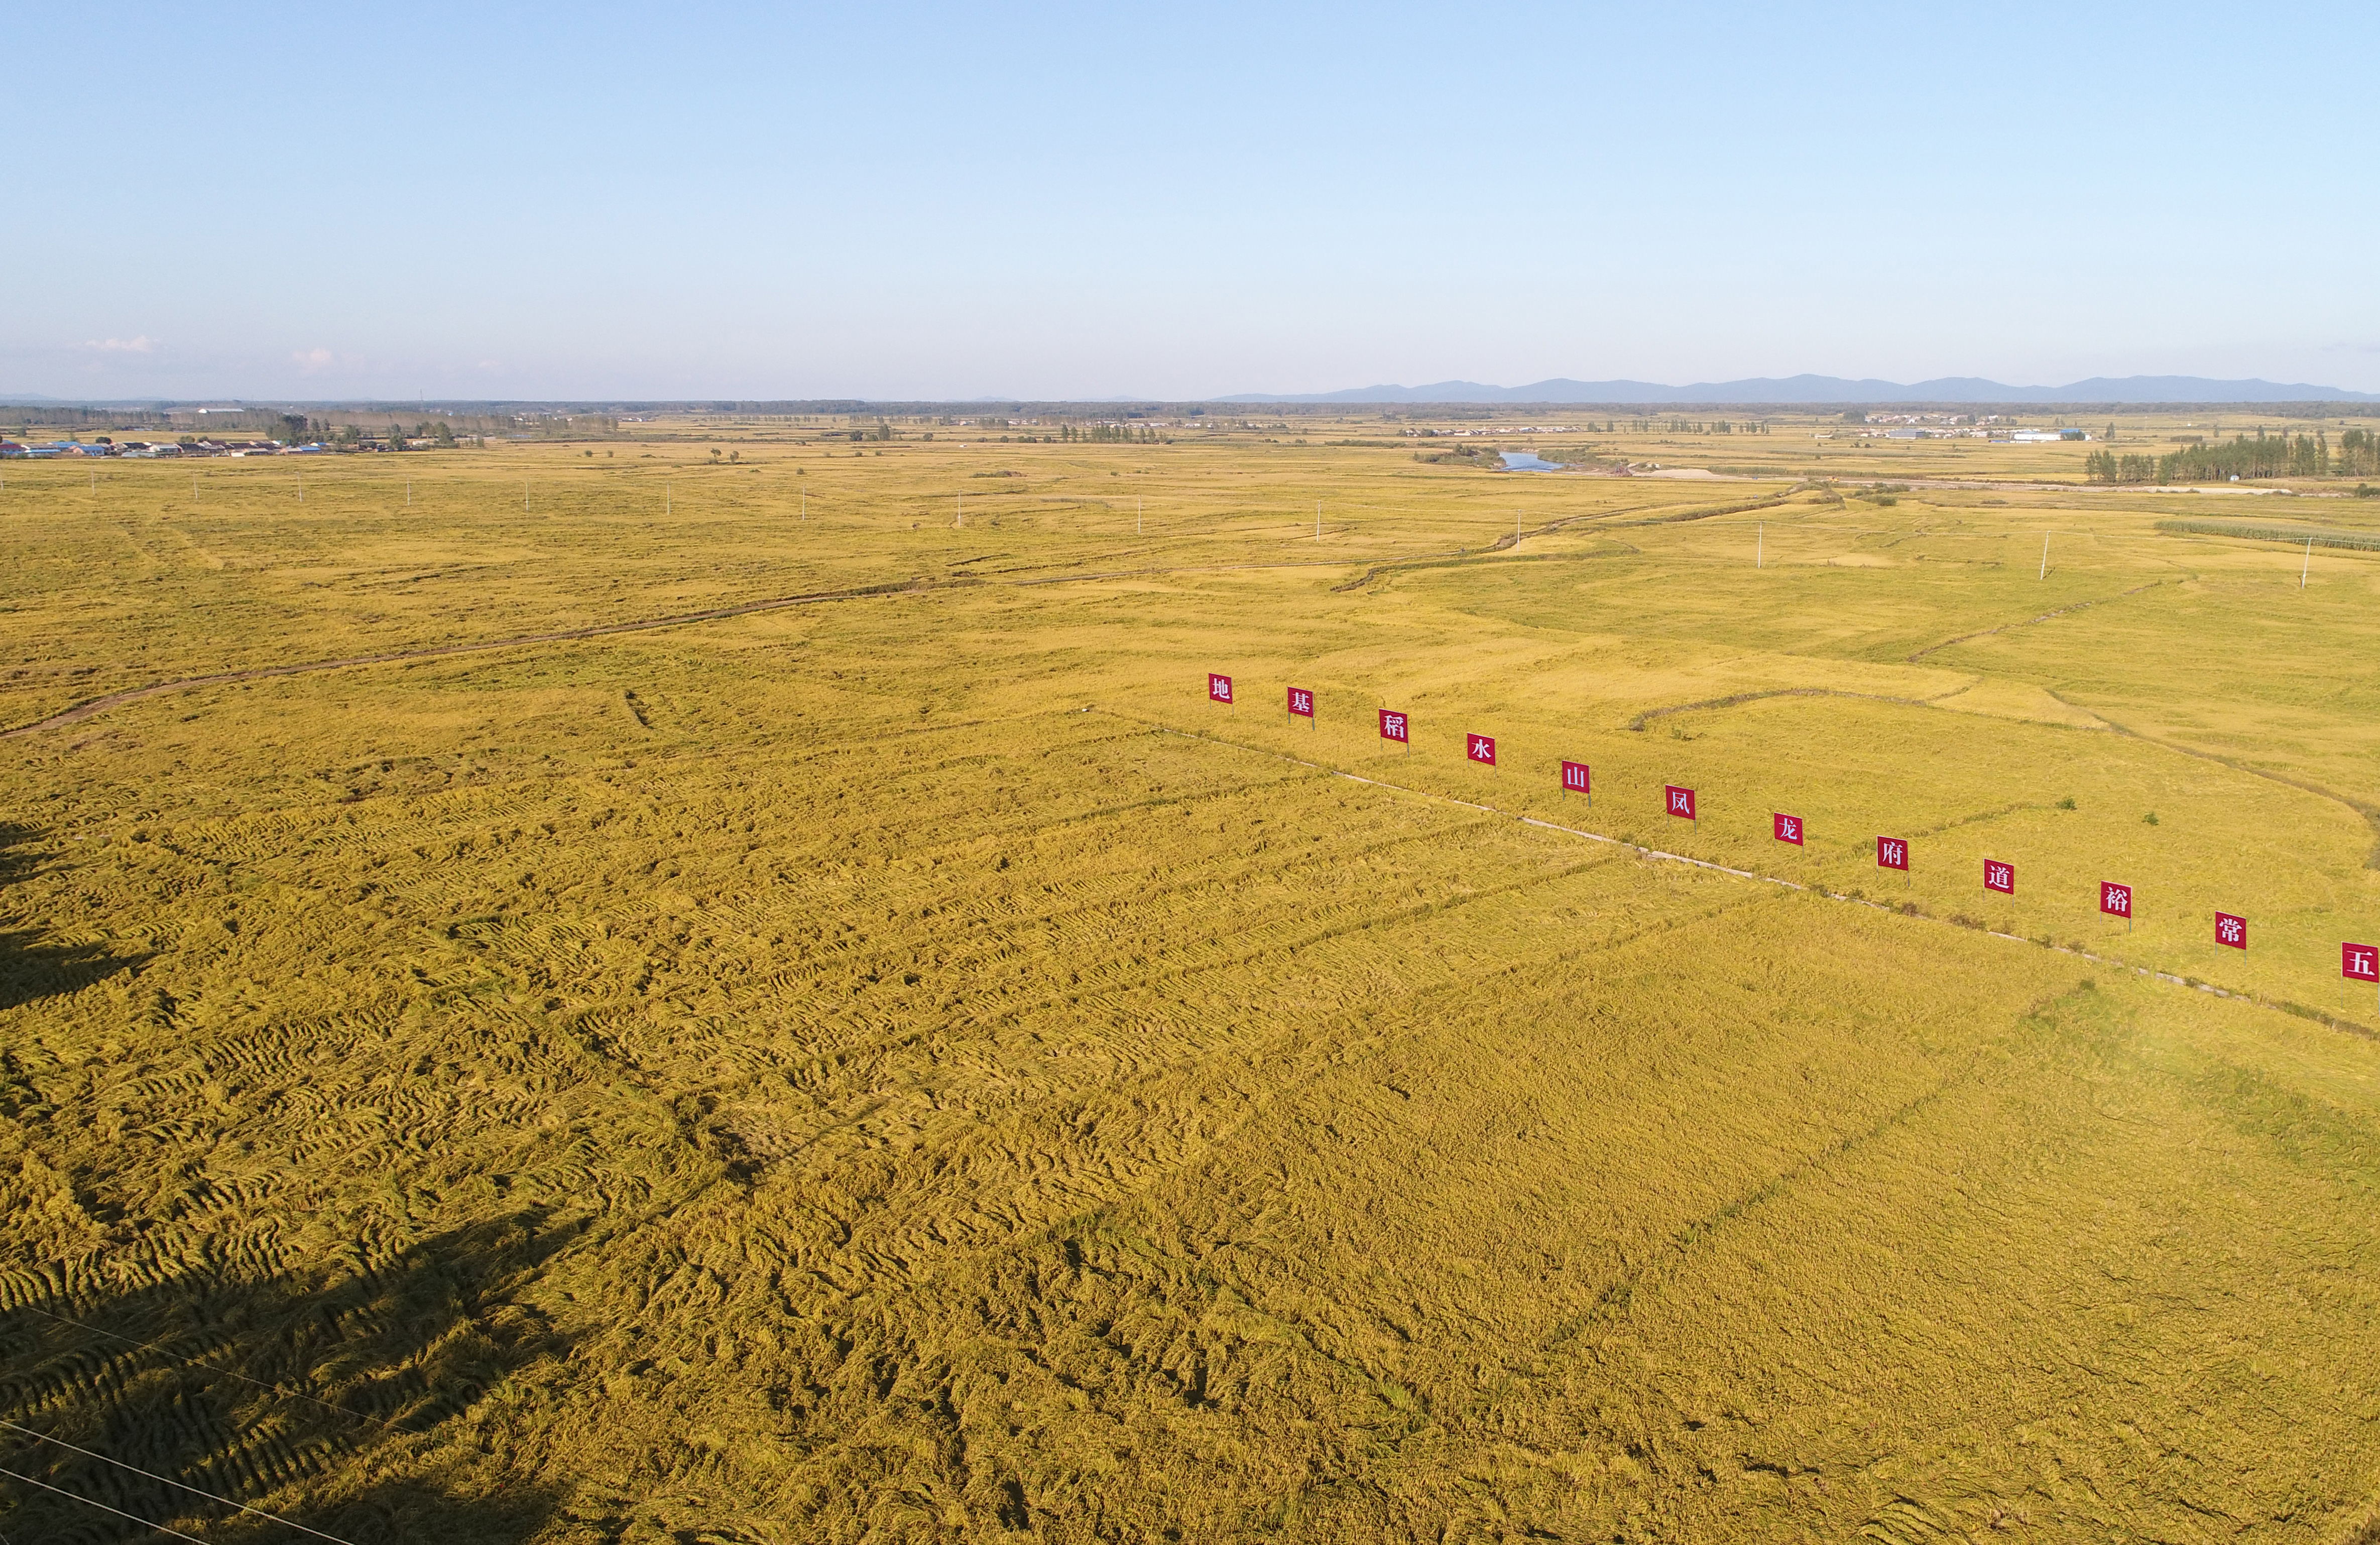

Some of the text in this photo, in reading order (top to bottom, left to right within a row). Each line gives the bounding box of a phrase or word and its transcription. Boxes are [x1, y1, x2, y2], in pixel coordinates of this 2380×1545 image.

[1213, 678, 1230, 699] 地
[1292, 692, 1310, 713] 基
[1384, 715, 1403, 738] 稻
[1472, 739, 1491, 758] 水
[1568, 767, 1584, 787] 山
[1672, 792, 1690, 814] 凤
[1779, 818, 1797, 839] 龙
[1883, 842, 1902, 865] 府
[1989, 865, 2010, 888] 道
[2106, 886, 2127, 912] 裕
[2219, 918, 2242, 942] 常
[2347, 951, 2374, 975] 五
